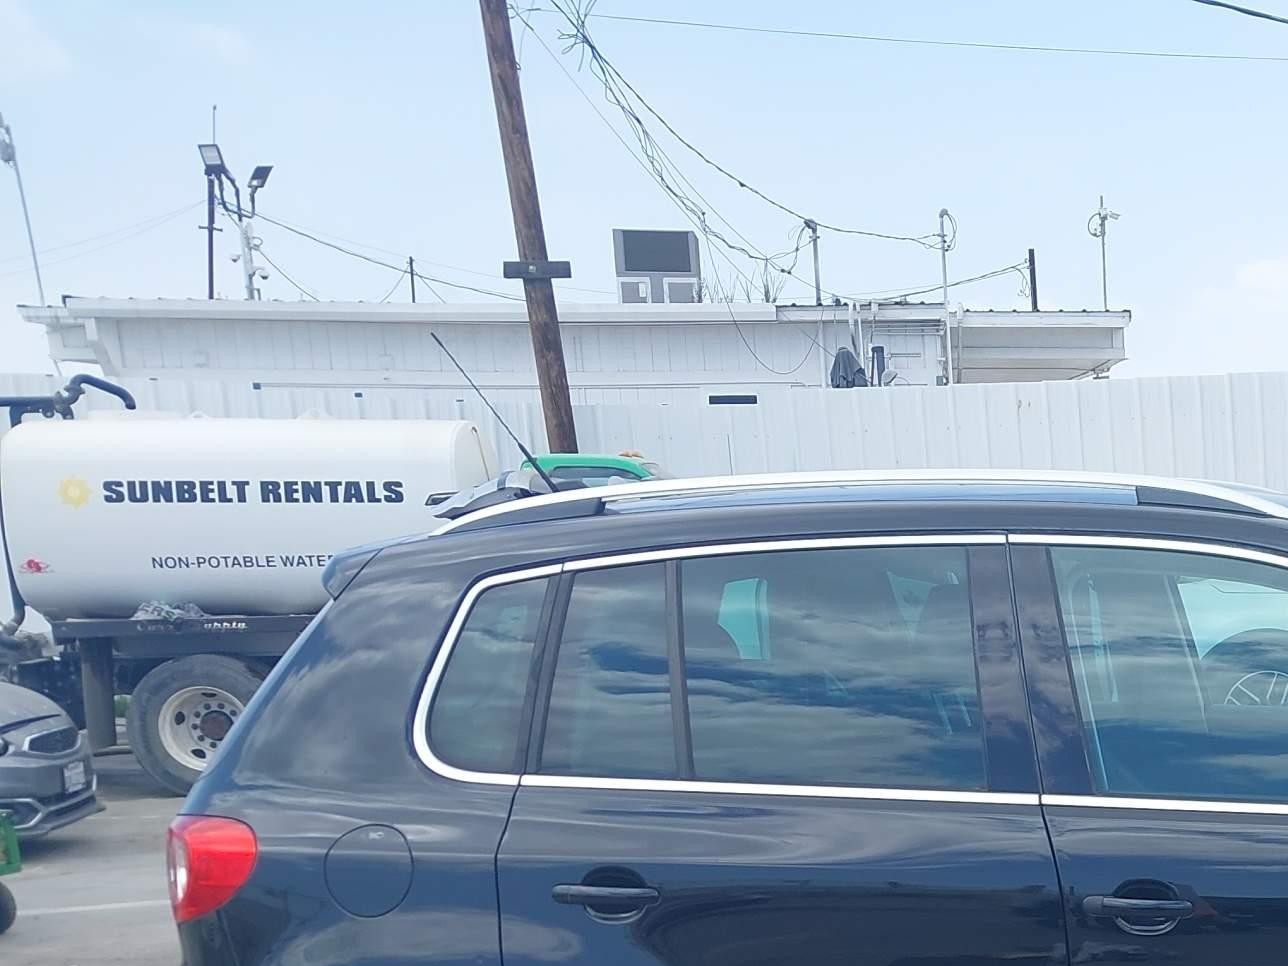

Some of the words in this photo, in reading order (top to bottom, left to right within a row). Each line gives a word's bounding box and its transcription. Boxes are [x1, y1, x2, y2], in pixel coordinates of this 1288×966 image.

[102, 480, 250, 504] SUNBELT
[260, 480, 405, 504] RENTALS
[151, 555, 277, 569] NON-POTABLE
